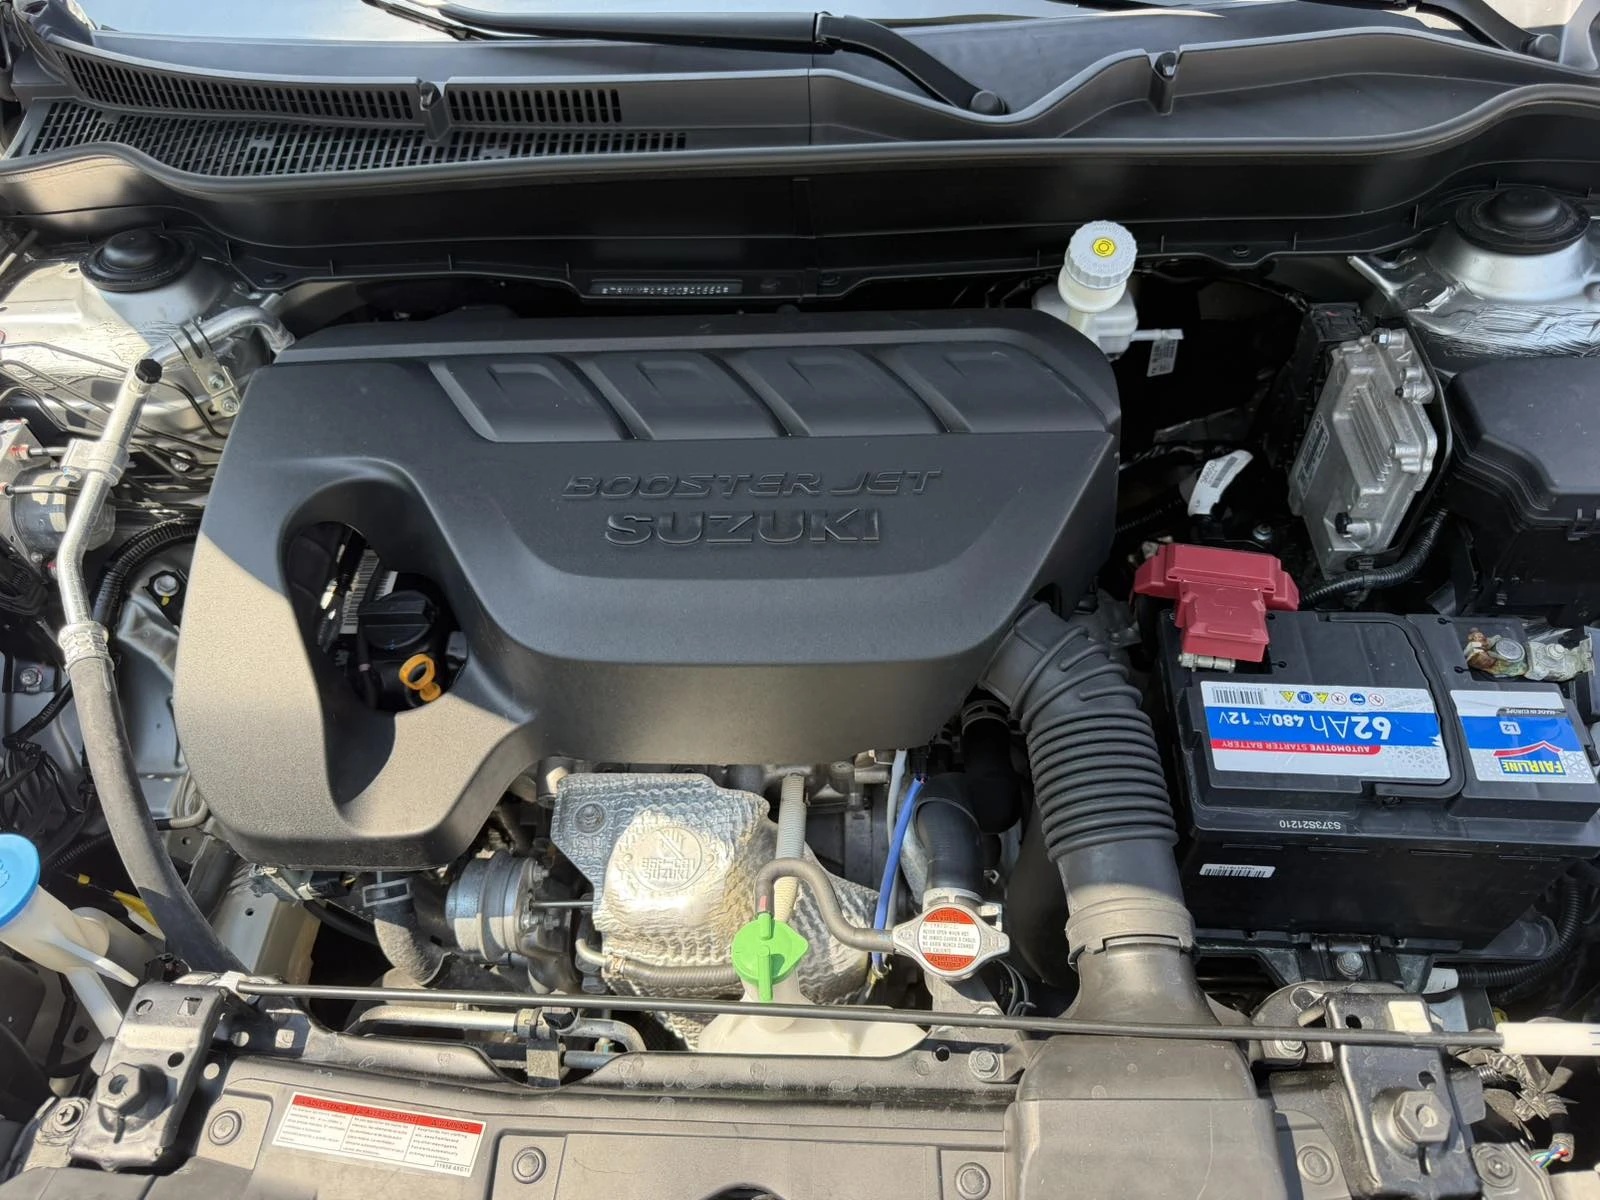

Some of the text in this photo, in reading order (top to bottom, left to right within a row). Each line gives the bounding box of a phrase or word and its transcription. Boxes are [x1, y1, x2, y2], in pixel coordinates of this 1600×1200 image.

[562, 467, 942, 498] BOOSTER JET
[604, 507, 881, 546] SUZUKI
[1218, 711, 1250, 725] 12V
[1309, 714, 1392, 740] 62Ah
[1221, 740, 1370, 753] AUTOMOTIVE STARTER BATTERY
[1502, 760, 1564, 774] FAIRLINE
[1279, 819, 1341, 830] S373S21210
[643, 868, 690, 880] SUZUKI
